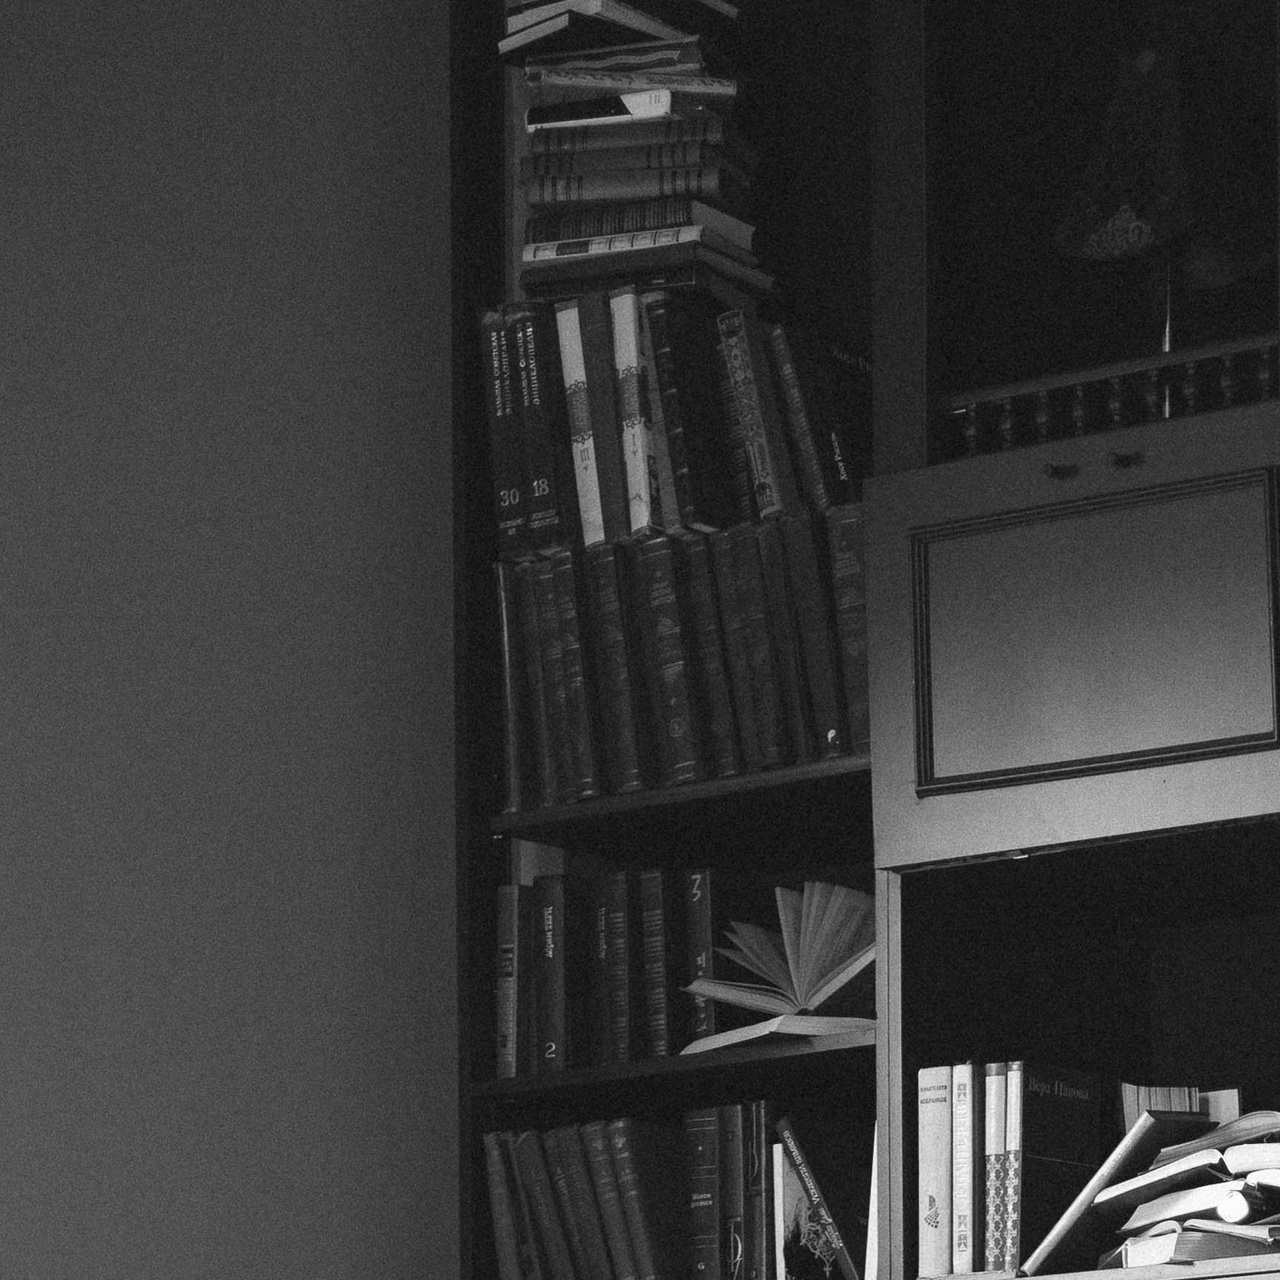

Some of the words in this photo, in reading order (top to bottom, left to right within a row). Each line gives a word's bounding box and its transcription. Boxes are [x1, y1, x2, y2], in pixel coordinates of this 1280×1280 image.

[532, 478, 549, 496] 18
[499, 488, 519, 506] 30
[545, 1042, 555, 1057] 2
